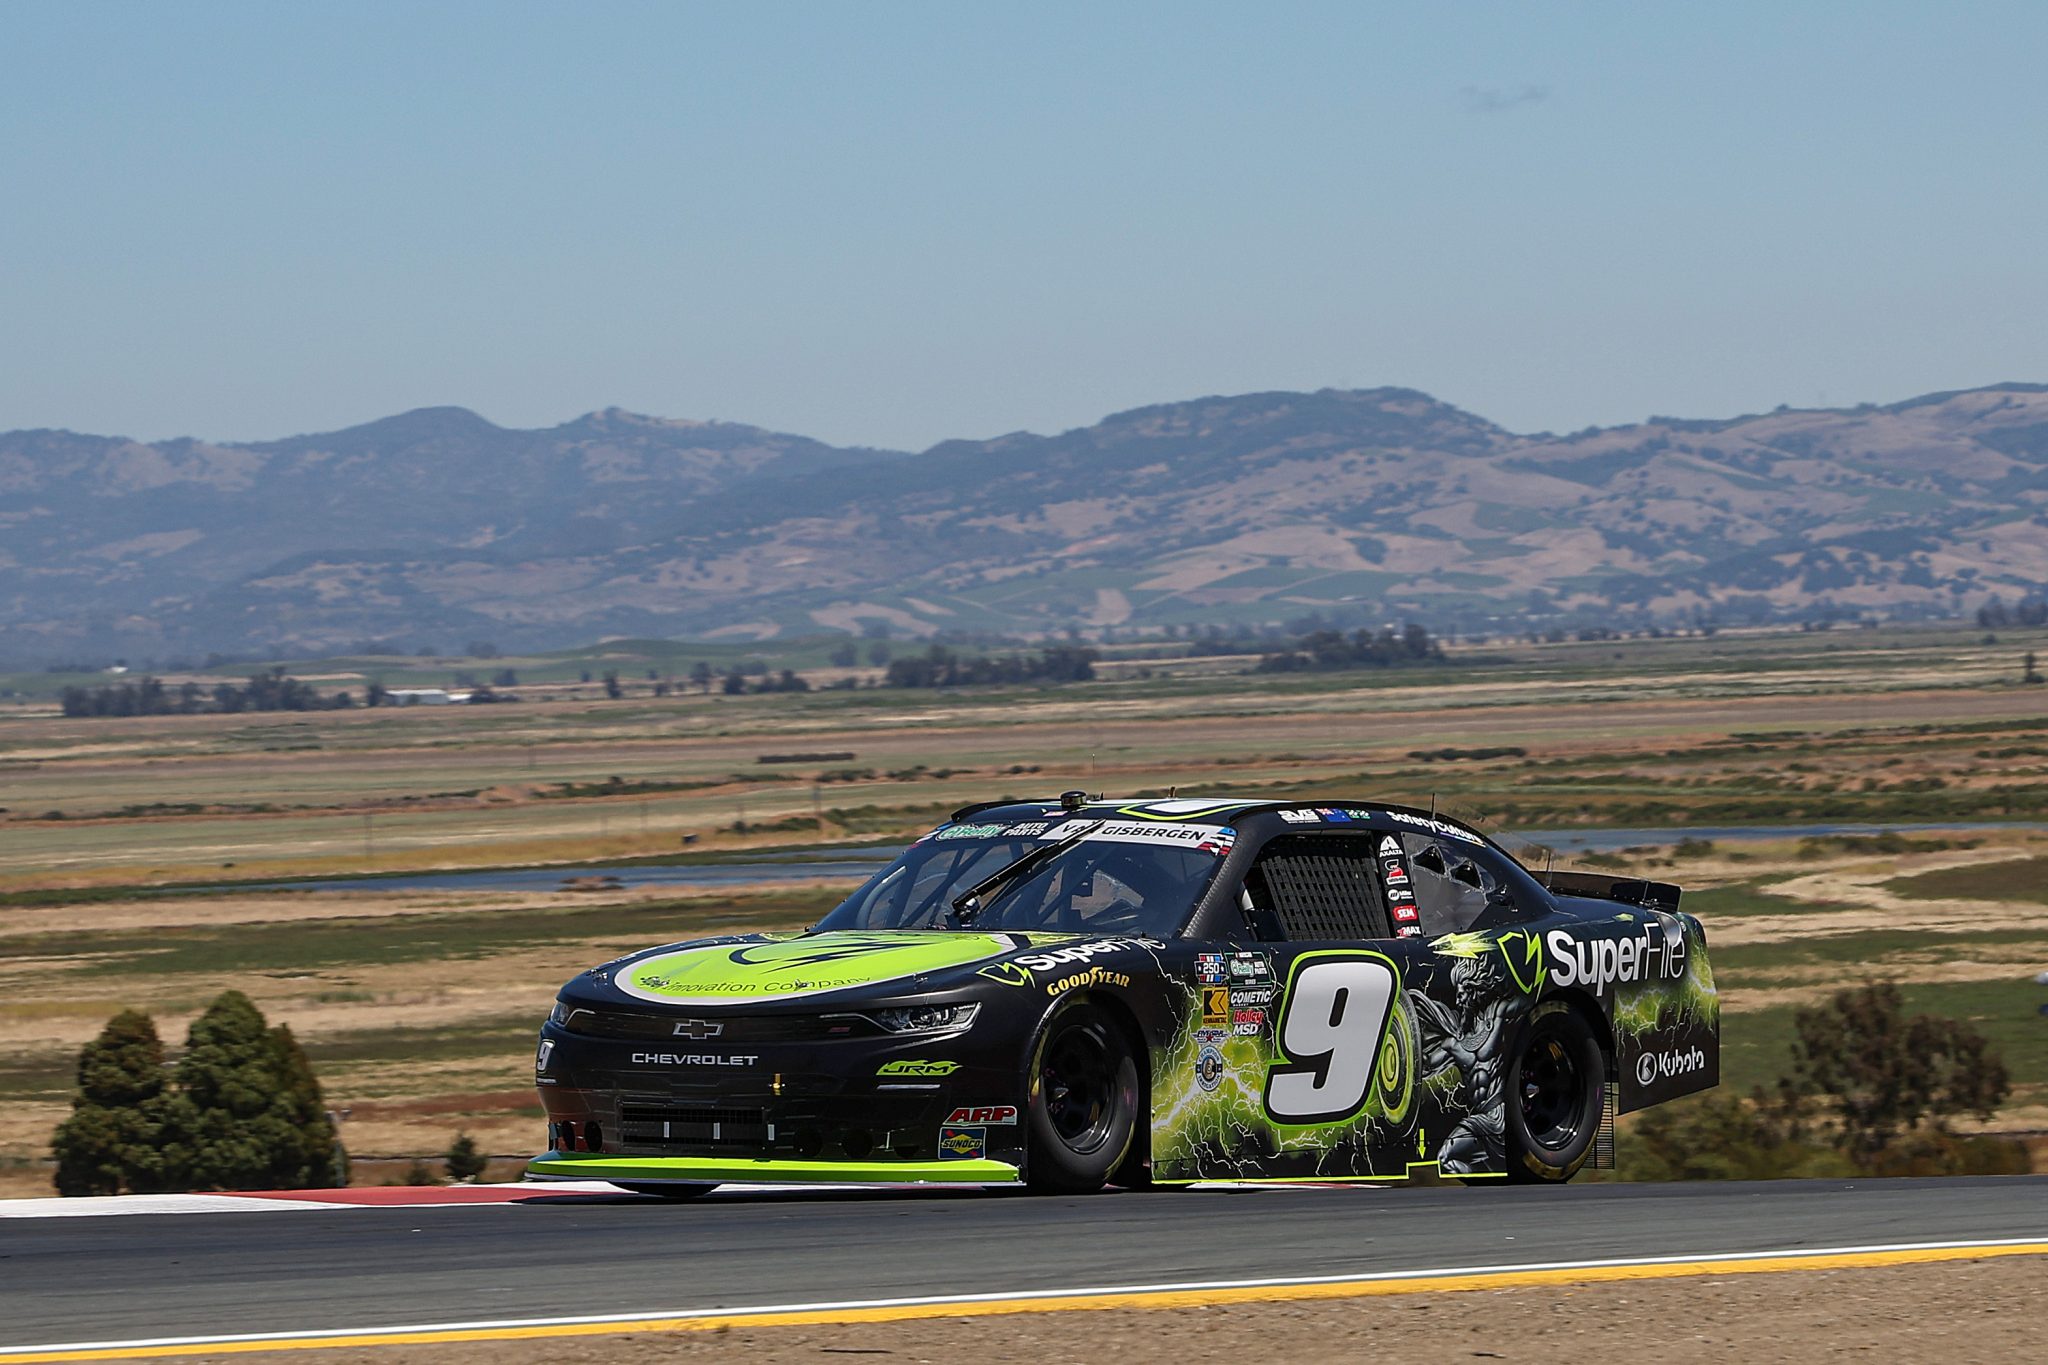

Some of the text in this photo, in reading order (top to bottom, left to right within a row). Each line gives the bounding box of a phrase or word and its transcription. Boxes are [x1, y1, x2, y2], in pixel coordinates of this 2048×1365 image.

[1003, 828, 1045, 836] PARTS
[1101, 826, 1205, 841] GISBERGEN
[1379, 849, 1403, 857] AXALTA
[1203, 963, 1220, 974] 250
[1046, 966, 1130, 996] GOODYEAR
[1230, 990, 1271, 1004] COMETIC
[1232, 1024, 1259, 1036] MSD
[1268, 961, 1393, 1116] 9
[536, 1041, 554, 1071] 9
[631, 1053, 758, 1066] CHEVROLET
[1658, 1045, 1705, 1077] Kubota
[883, 1065, 949, 1074] JRM
[948, 1106, 1017, 1122] ARP
[942, 1139, 982, 1148] SUNOCO
